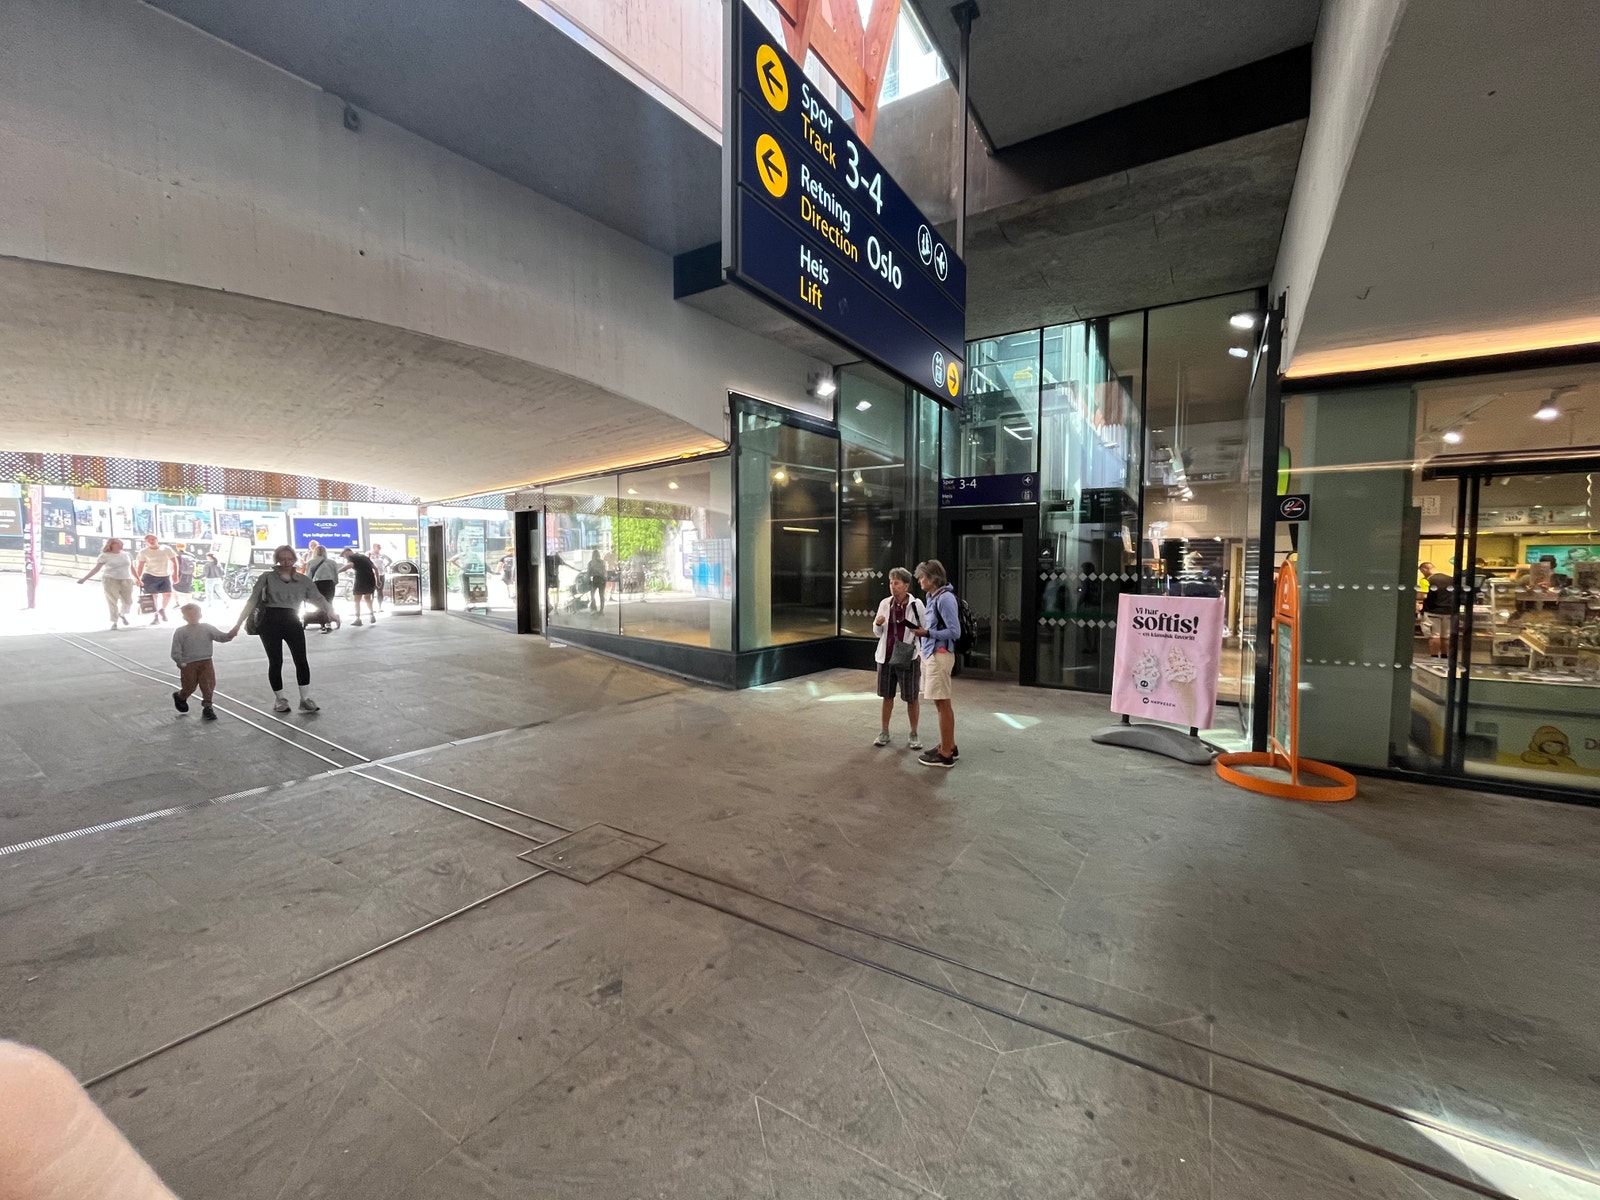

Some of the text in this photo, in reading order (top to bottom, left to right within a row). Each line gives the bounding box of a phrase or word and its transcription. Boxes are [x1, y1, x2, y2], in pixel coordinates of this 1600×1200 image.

[801, 83, 834, 134] Spor
[801, 112, 837, 170] Track
[801, 164, 851, 233] Retning
[845, 140, 884, 215] 3-4
[801, 195, 858, 263] Direction
[800, 244, 830, 285] Heis
[866, 235, 902, 290] Oslo
[800, 275, 823, 311] Lift
[959, 478, 977, 490] 3-4
[1132, 613, 1199, 635] softis!
[1135, 607, 1144, 615] Vi
